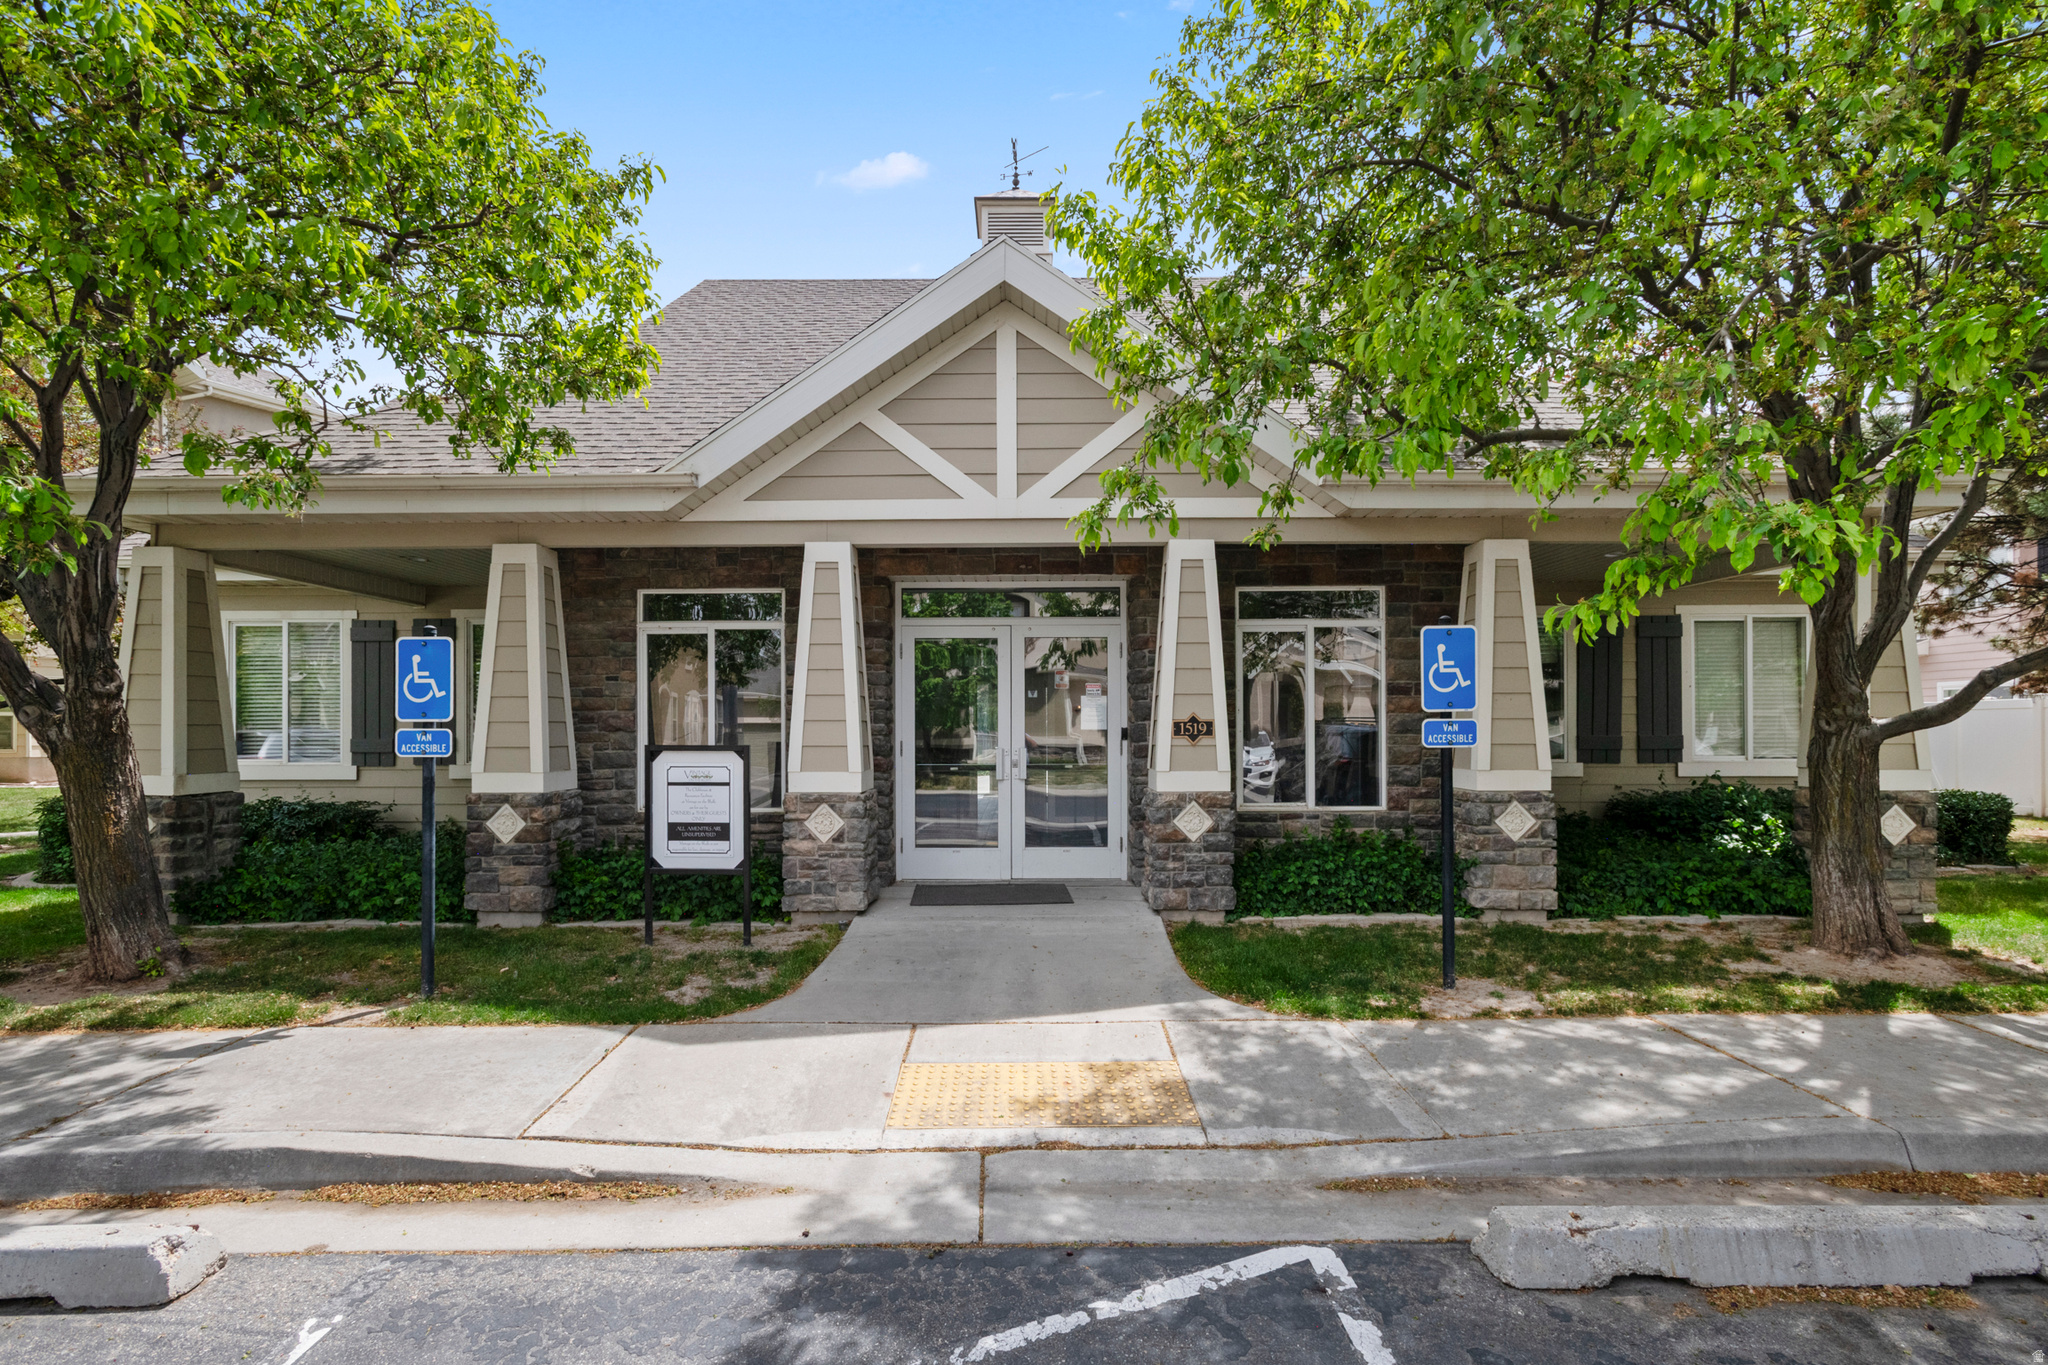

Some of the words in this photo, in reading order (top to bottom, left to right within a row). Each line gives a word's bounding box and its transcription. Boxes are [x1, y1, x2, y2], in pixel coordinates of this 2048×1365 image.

[1179, 722, 1207, 735] 1519
[1443, 723, 1459, 732] VAN
[416, 733, 432, 742] VAN
[1428, 734, 1474, 743] ACCESSIBLE
[401, 744, 447, 753] ACCESSIBLE
